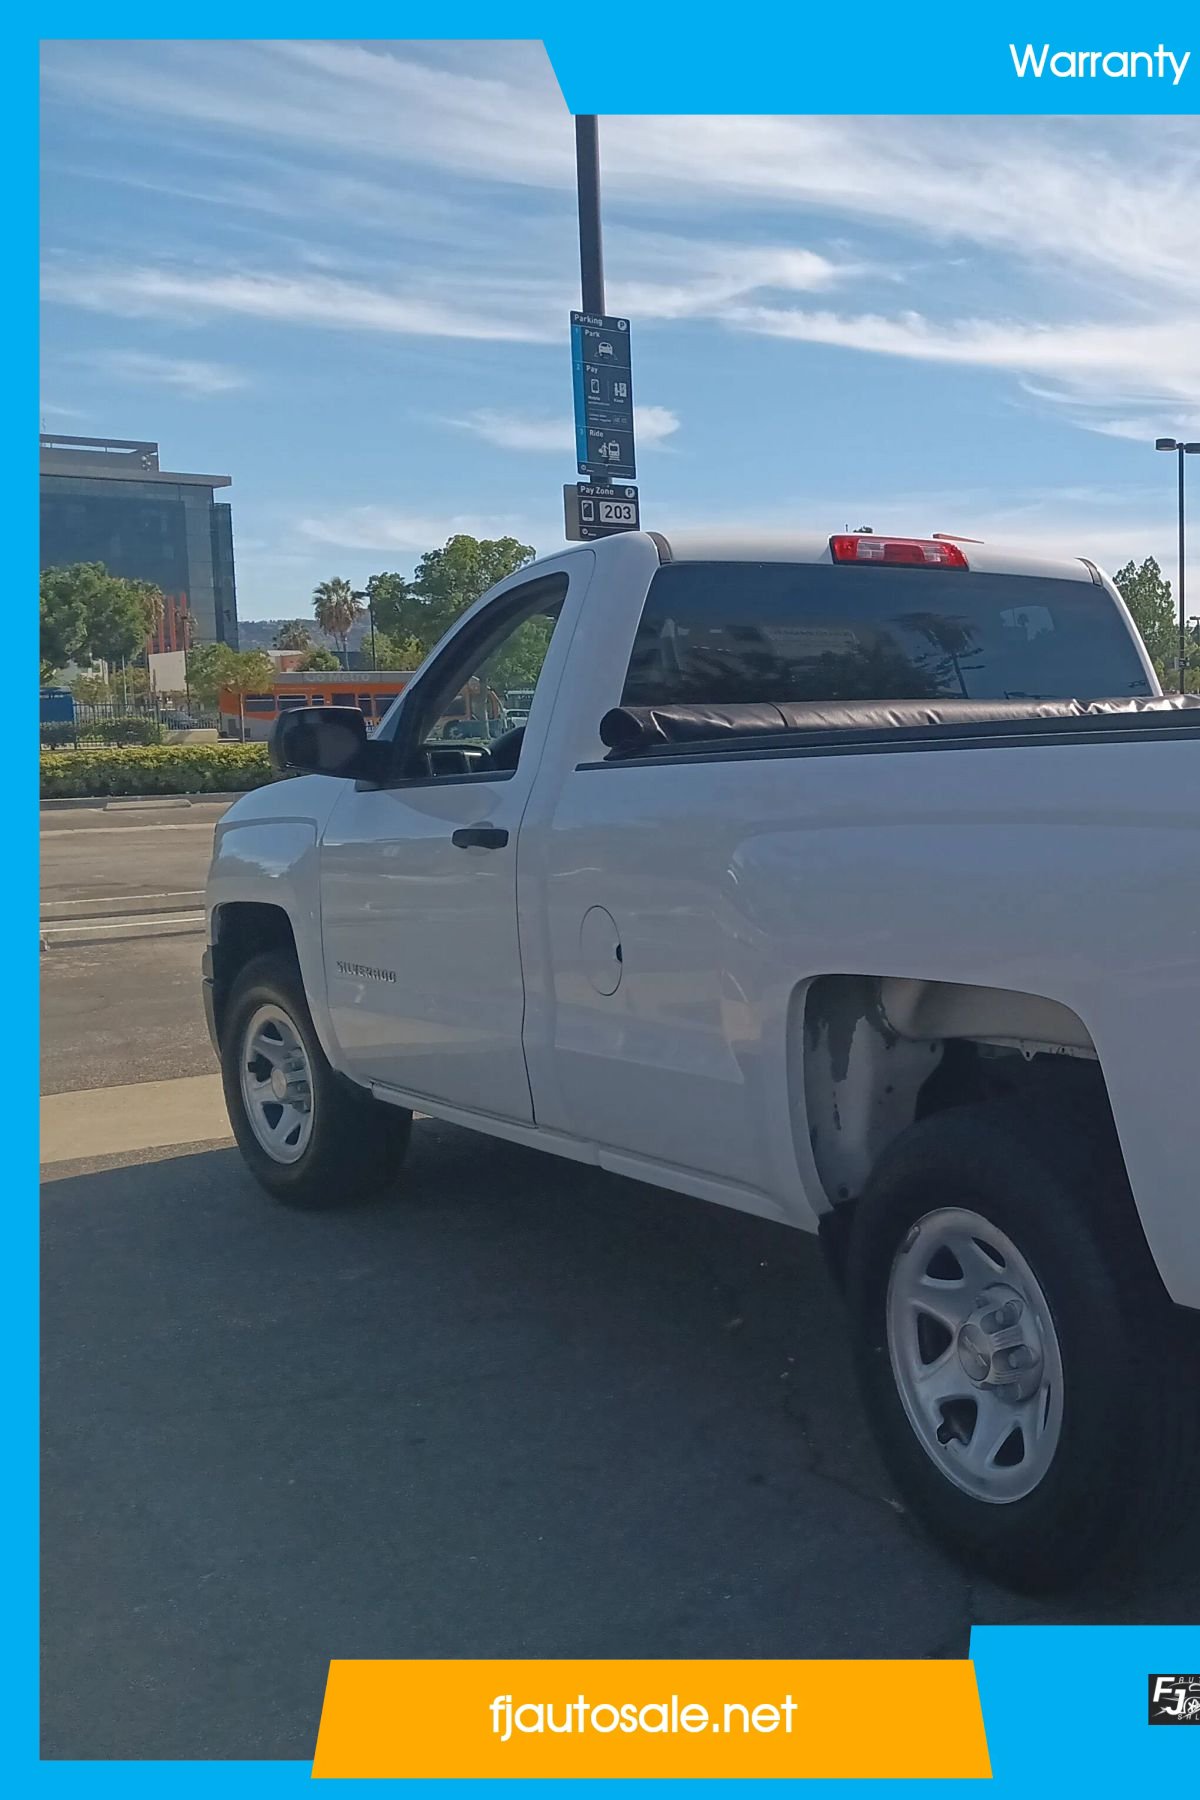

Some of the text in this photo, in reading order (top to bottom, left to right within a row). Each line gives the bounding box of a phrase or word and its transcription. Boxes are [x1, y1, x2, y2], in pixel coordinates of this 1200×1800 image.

[574, 313, 603, 327] Parking
[584, 329, 600, 338] Park
[586, 364, 598, 374] Pay
[589, 429, 604, 438] Ride
[580, 485, 614, 496] Pay Zone
[604, 504, 632, 520] 203
[335, 960, 397, 984] SILVERADO
